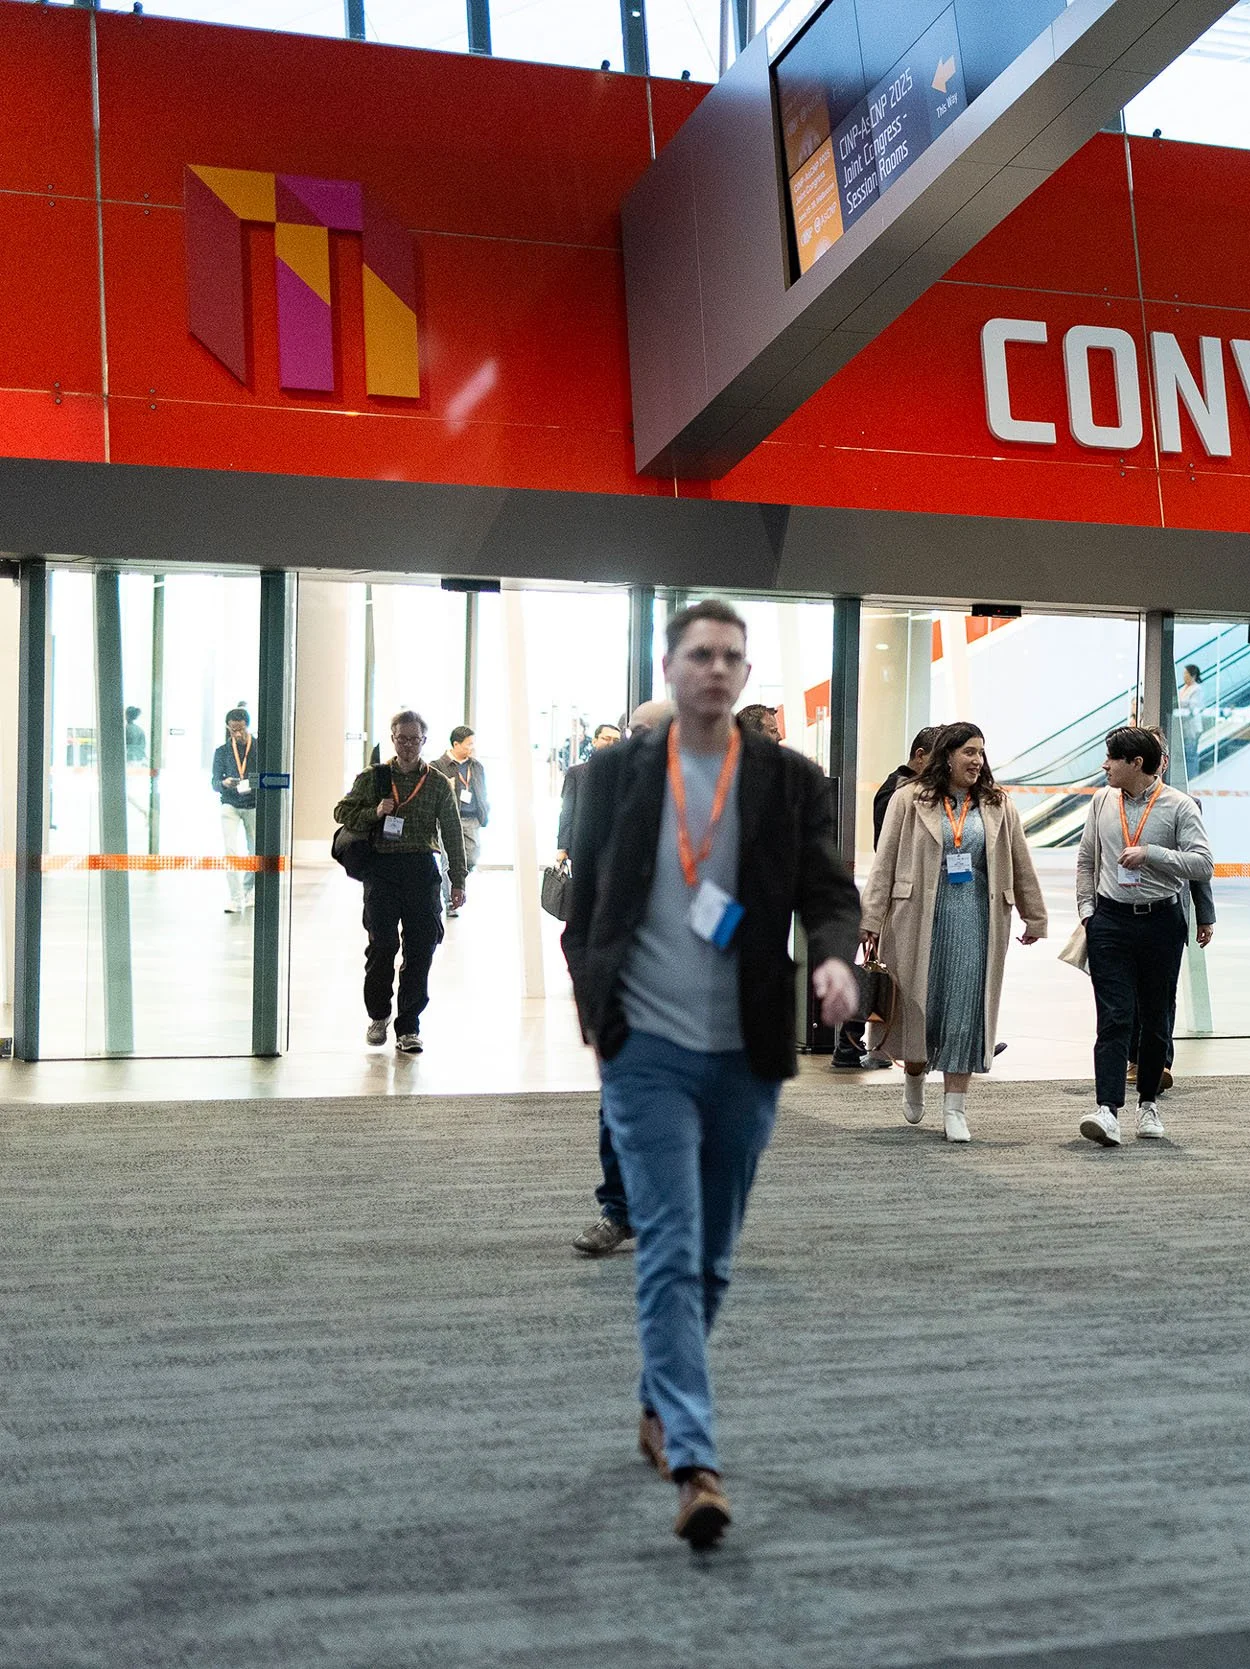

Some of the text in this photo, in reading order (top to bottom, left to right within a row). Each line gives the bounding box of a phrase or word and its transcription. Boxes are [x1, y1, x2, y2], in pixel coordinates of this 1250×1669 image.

[839, 67, 914, 161] CINP-AsCNP 2025
[936, 92, 958, 119] This Way
[843, 153, 864, 189] Joint
[863, 114, 902, 166] Congress
[846, 139, 909, 215] Session Rooms
